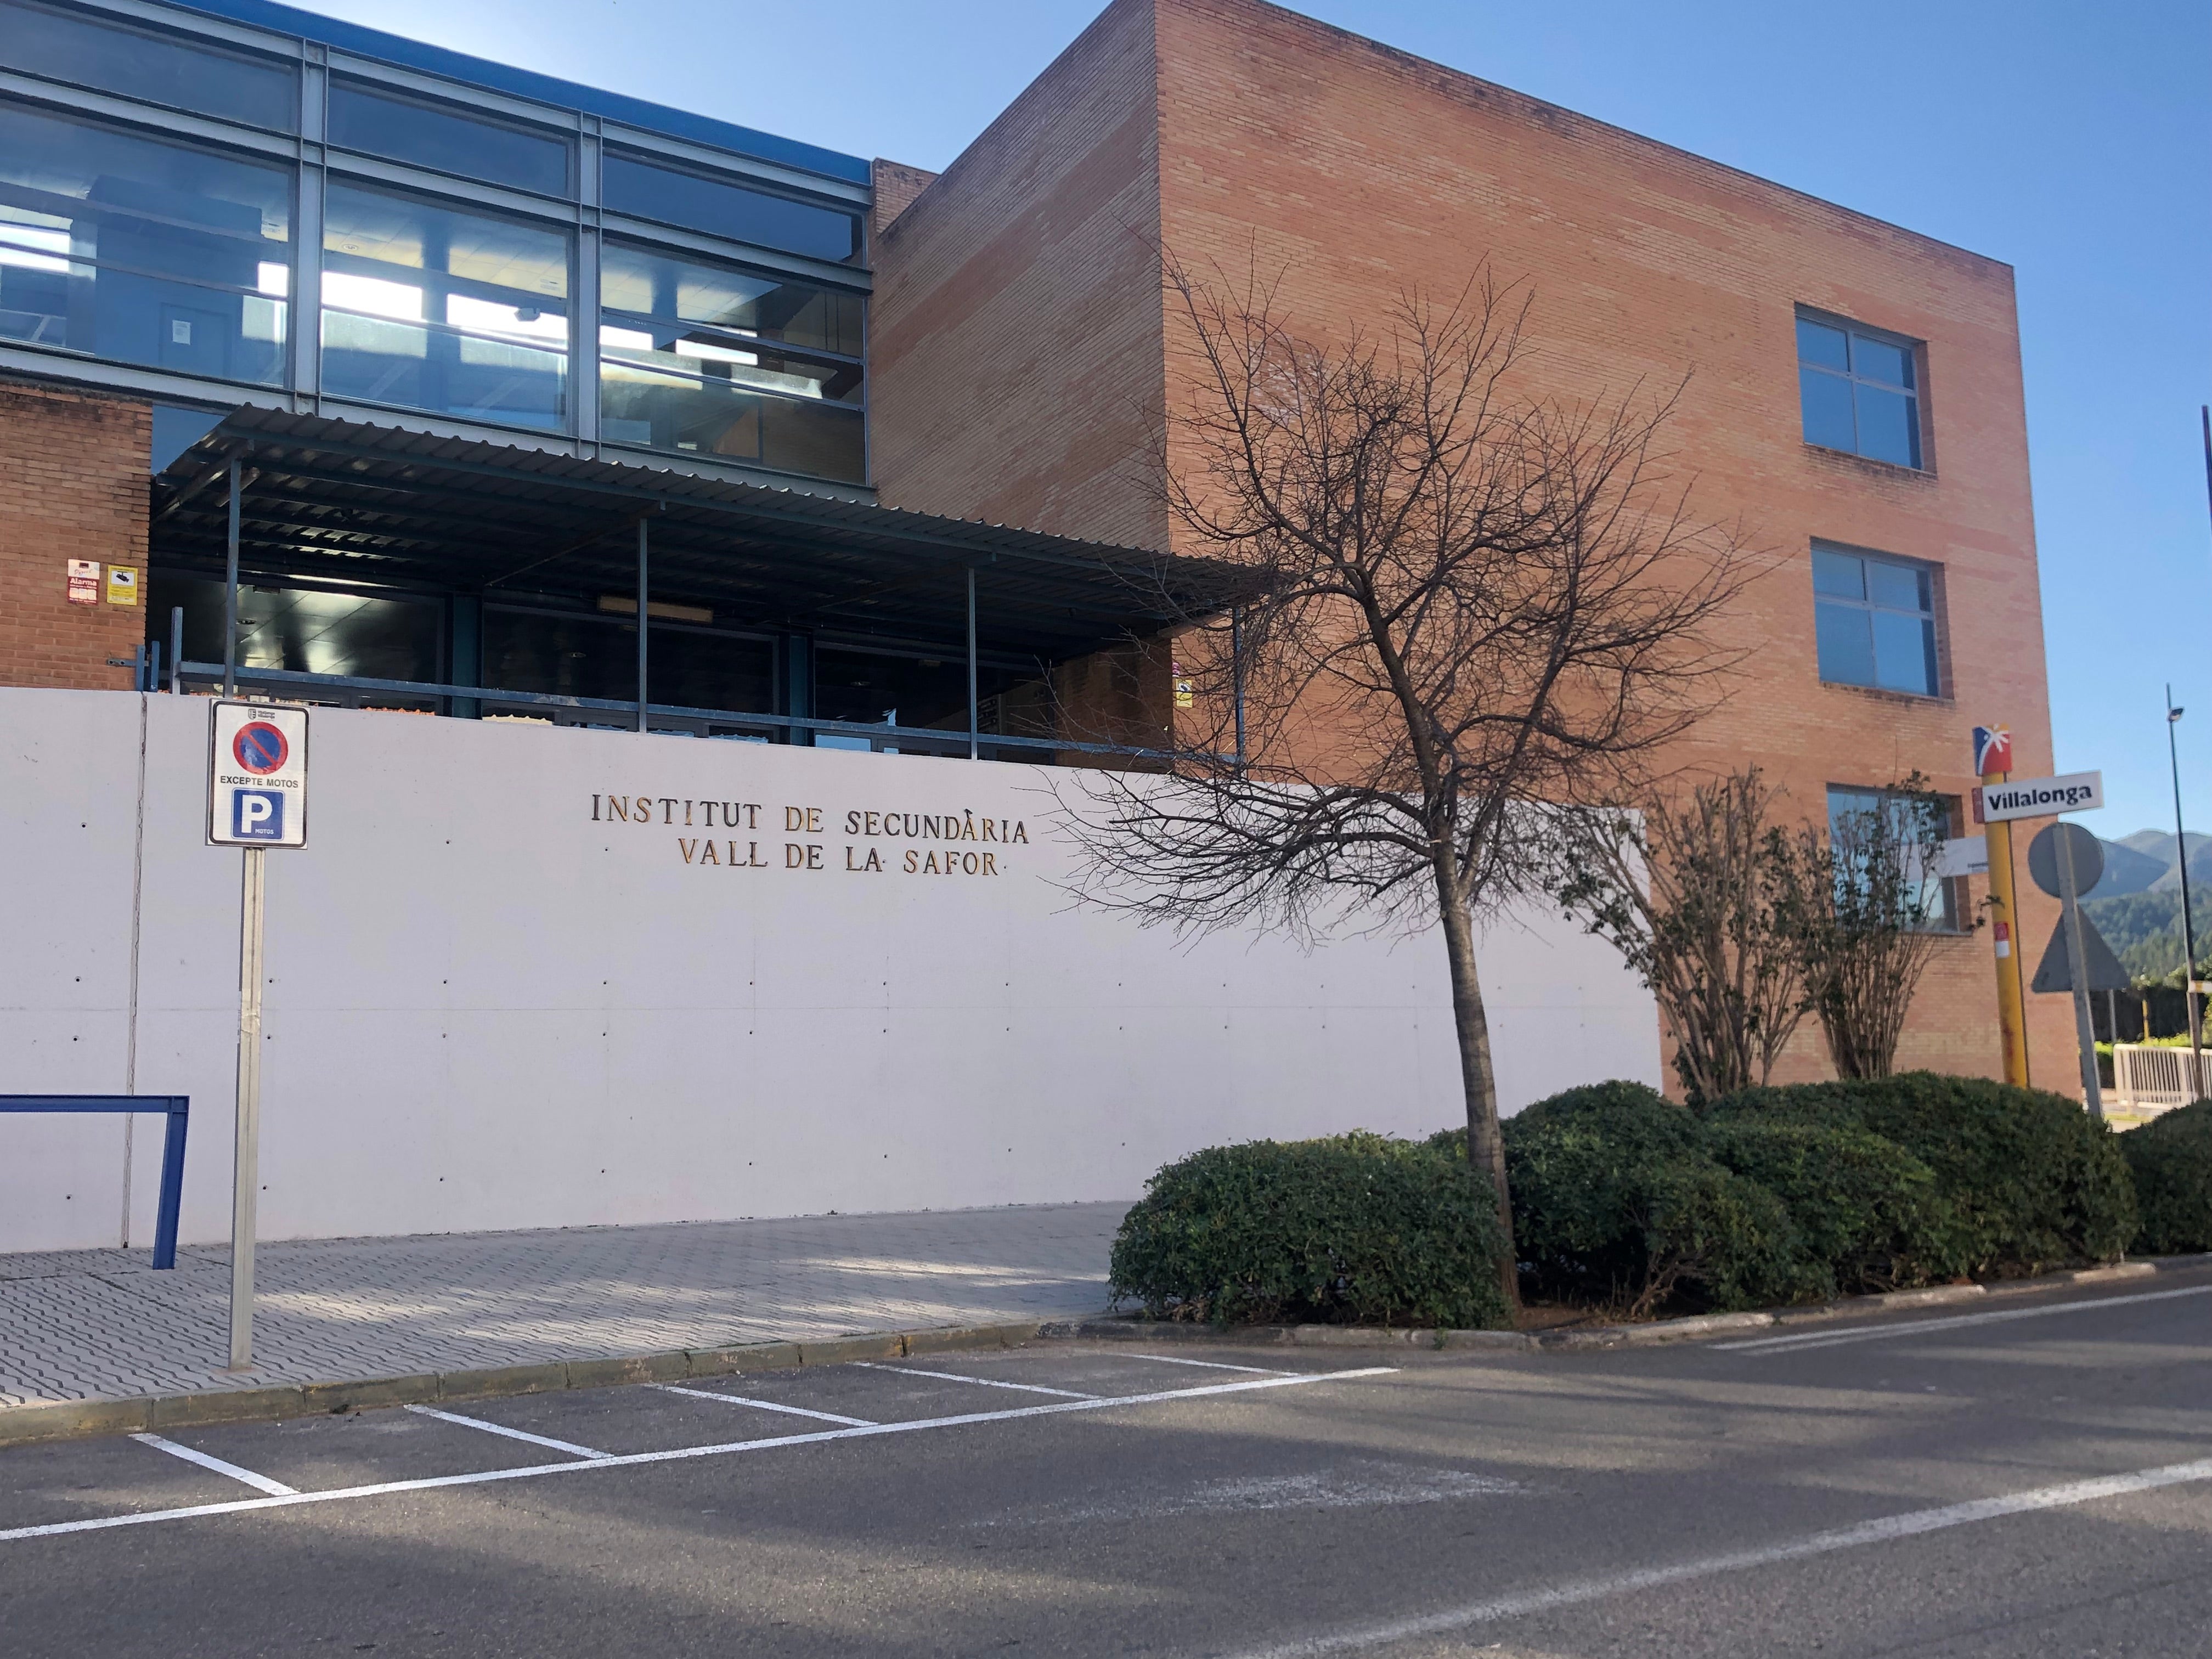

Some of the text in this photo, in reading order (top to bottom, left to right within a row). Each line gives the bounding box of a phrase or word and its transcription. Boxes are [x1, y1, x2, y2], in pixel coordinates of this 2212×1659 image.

[70, 578, 97, 586] Alarma
[220, 776, 298, 788] EXCEPTE MOTOS
[1989, 785, 2092, 811] Villalonga
[242, 795, 273, 833] P
[592, 794, 1029, 844] INSTITUT DE SECUNDÀRIA
[678, 838, 998, 876] VALL DE LA SAFOR
